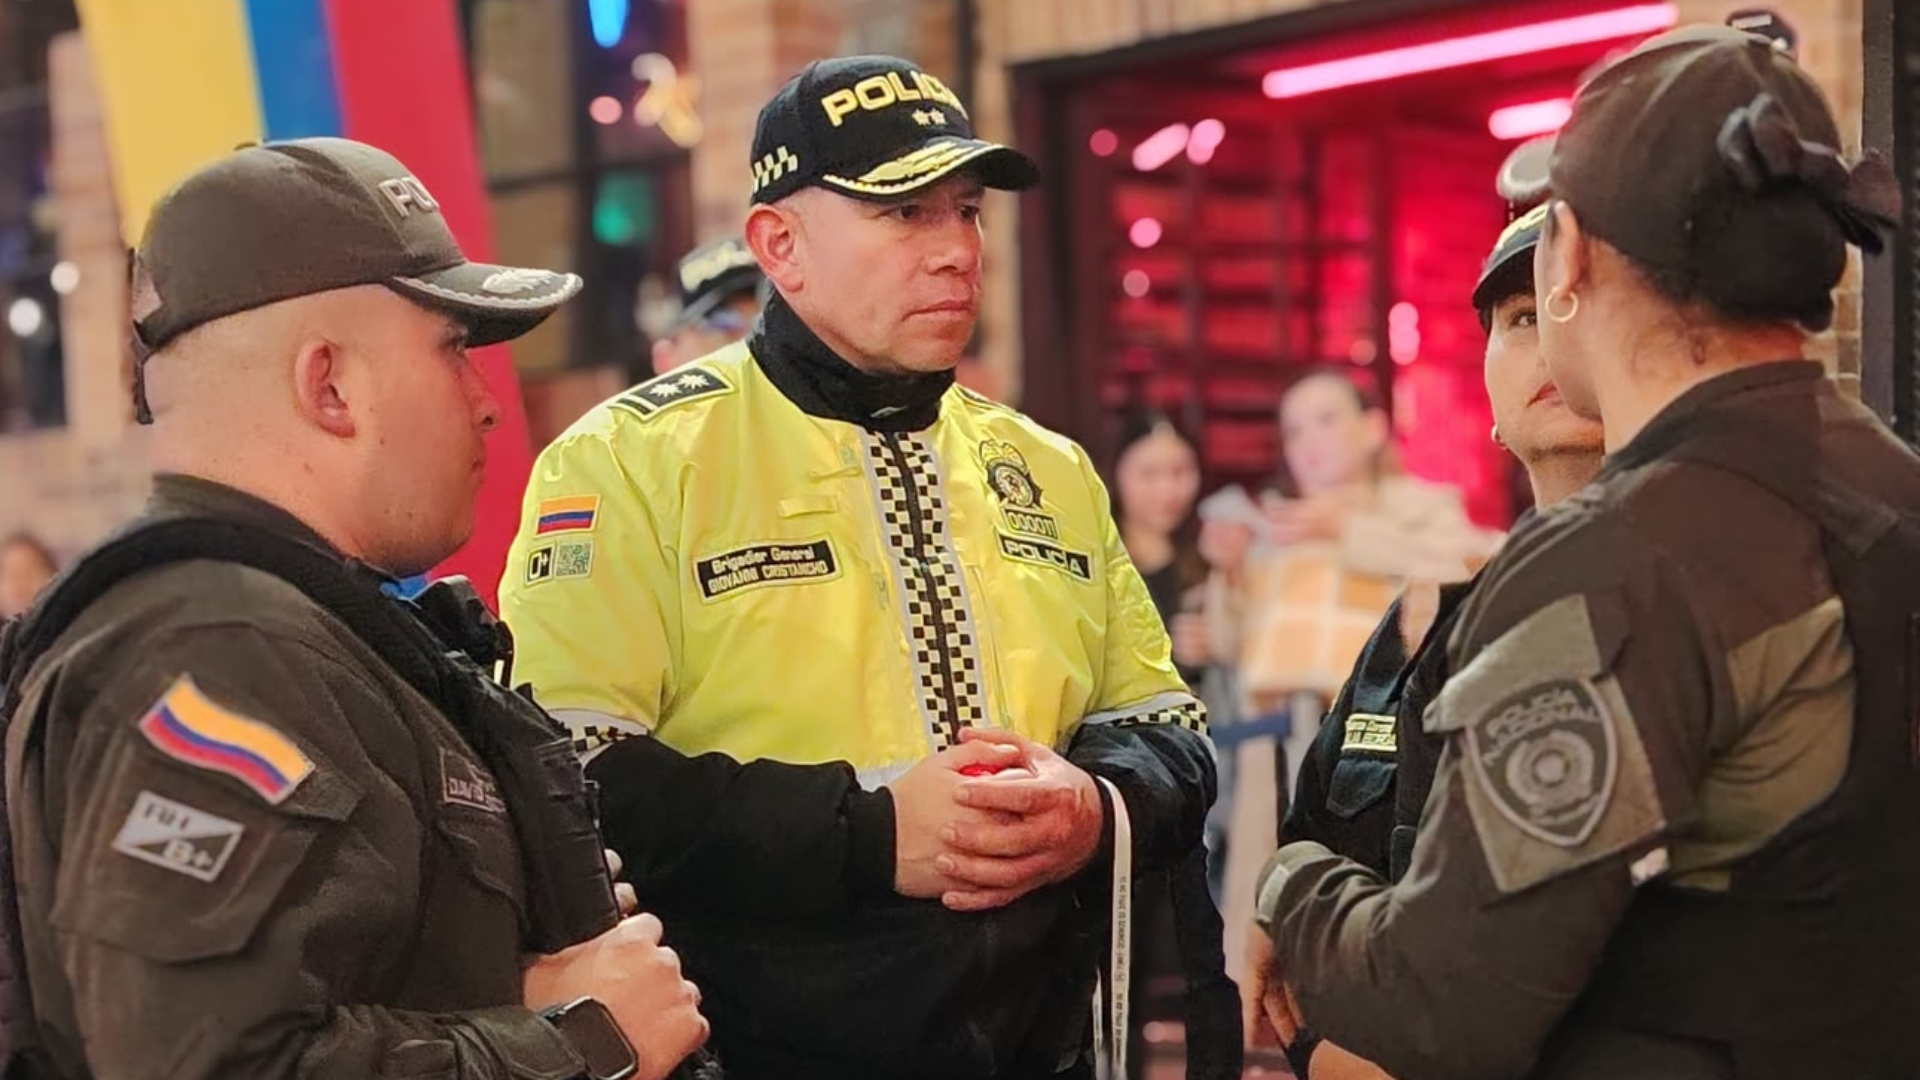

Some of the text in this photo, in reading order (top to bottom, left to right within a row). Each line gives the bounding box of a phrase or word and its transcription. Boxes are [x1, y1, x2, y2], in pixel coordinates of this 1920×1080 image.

[707, 559, 829, 594] GIOVANNI CRISTANCHO
[711, 546, 815, 575] Brigadier General
